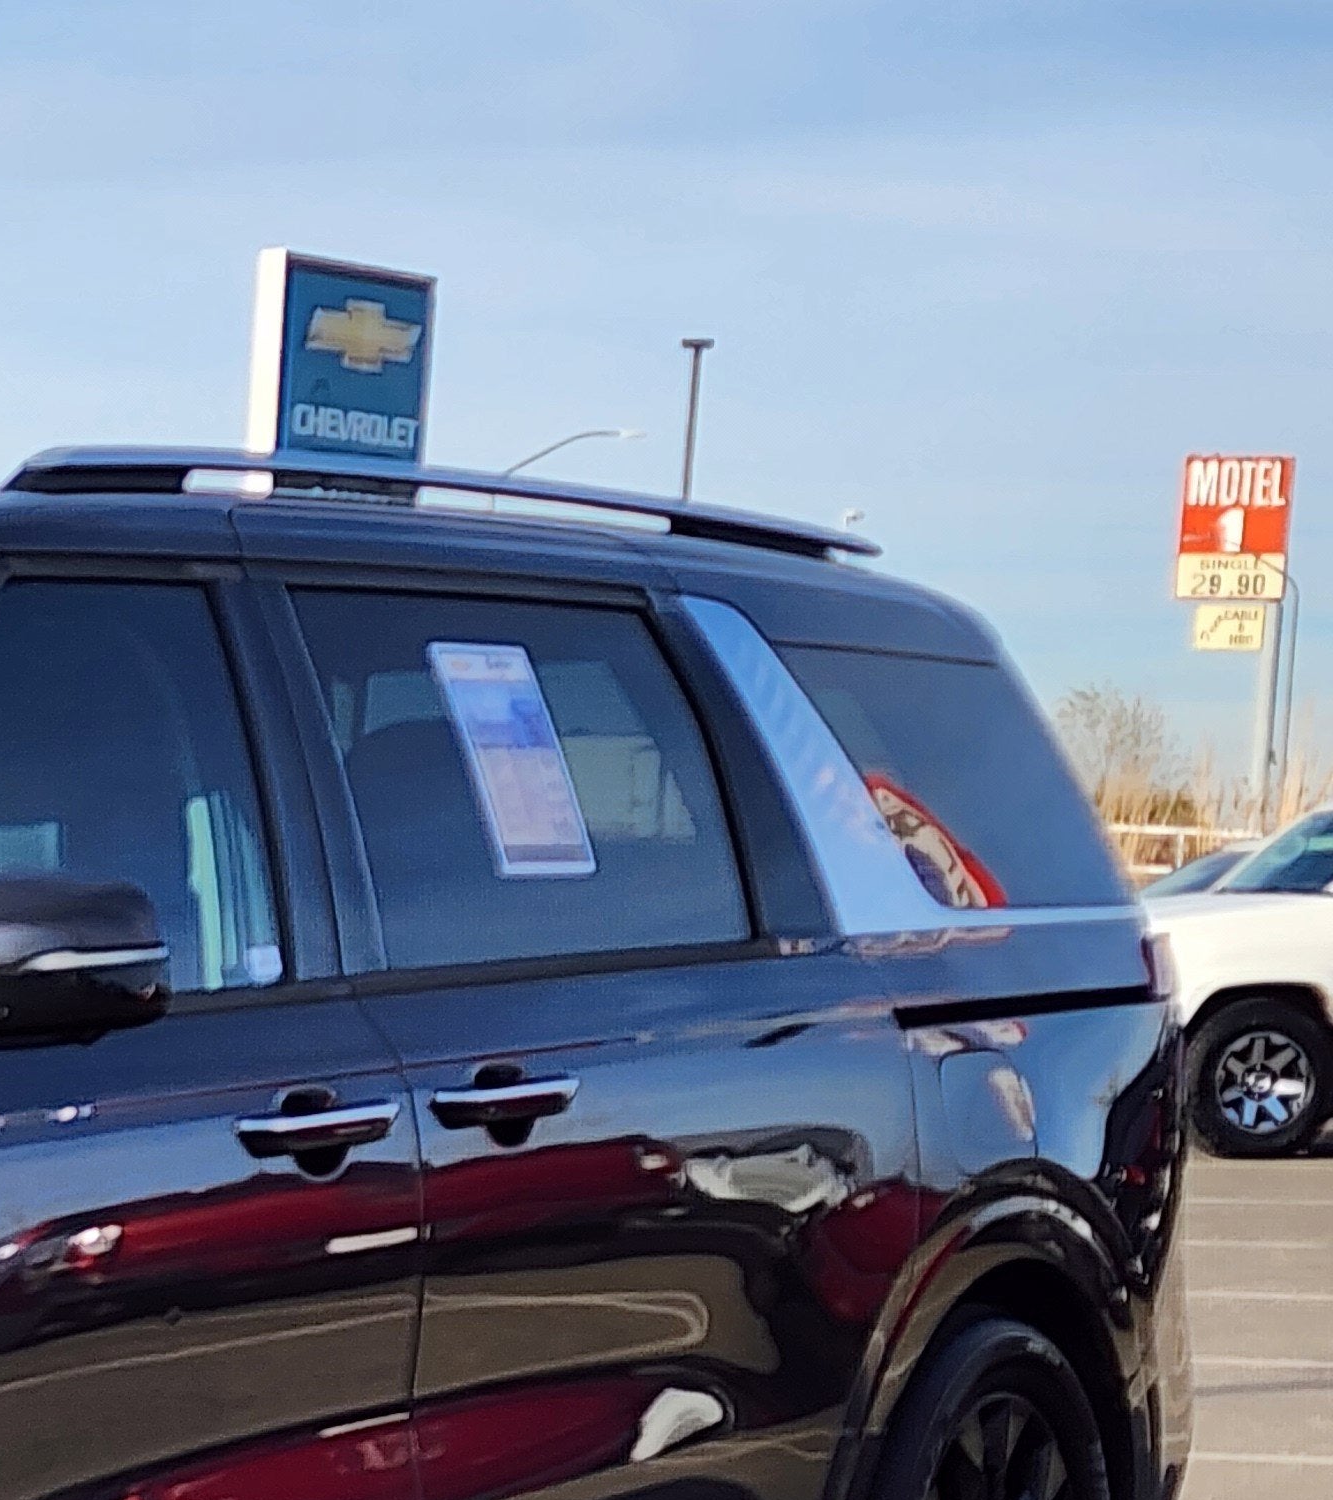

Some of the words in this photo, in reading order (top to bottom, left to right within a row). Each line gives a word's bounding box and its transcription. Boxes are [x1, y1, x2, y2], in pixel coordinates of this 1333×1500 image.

[292, 404, 419, 448] CHEVROLET
[1187, 458, 1286, 507] MOTEL
[1217, 507, 1245, 553] 1
